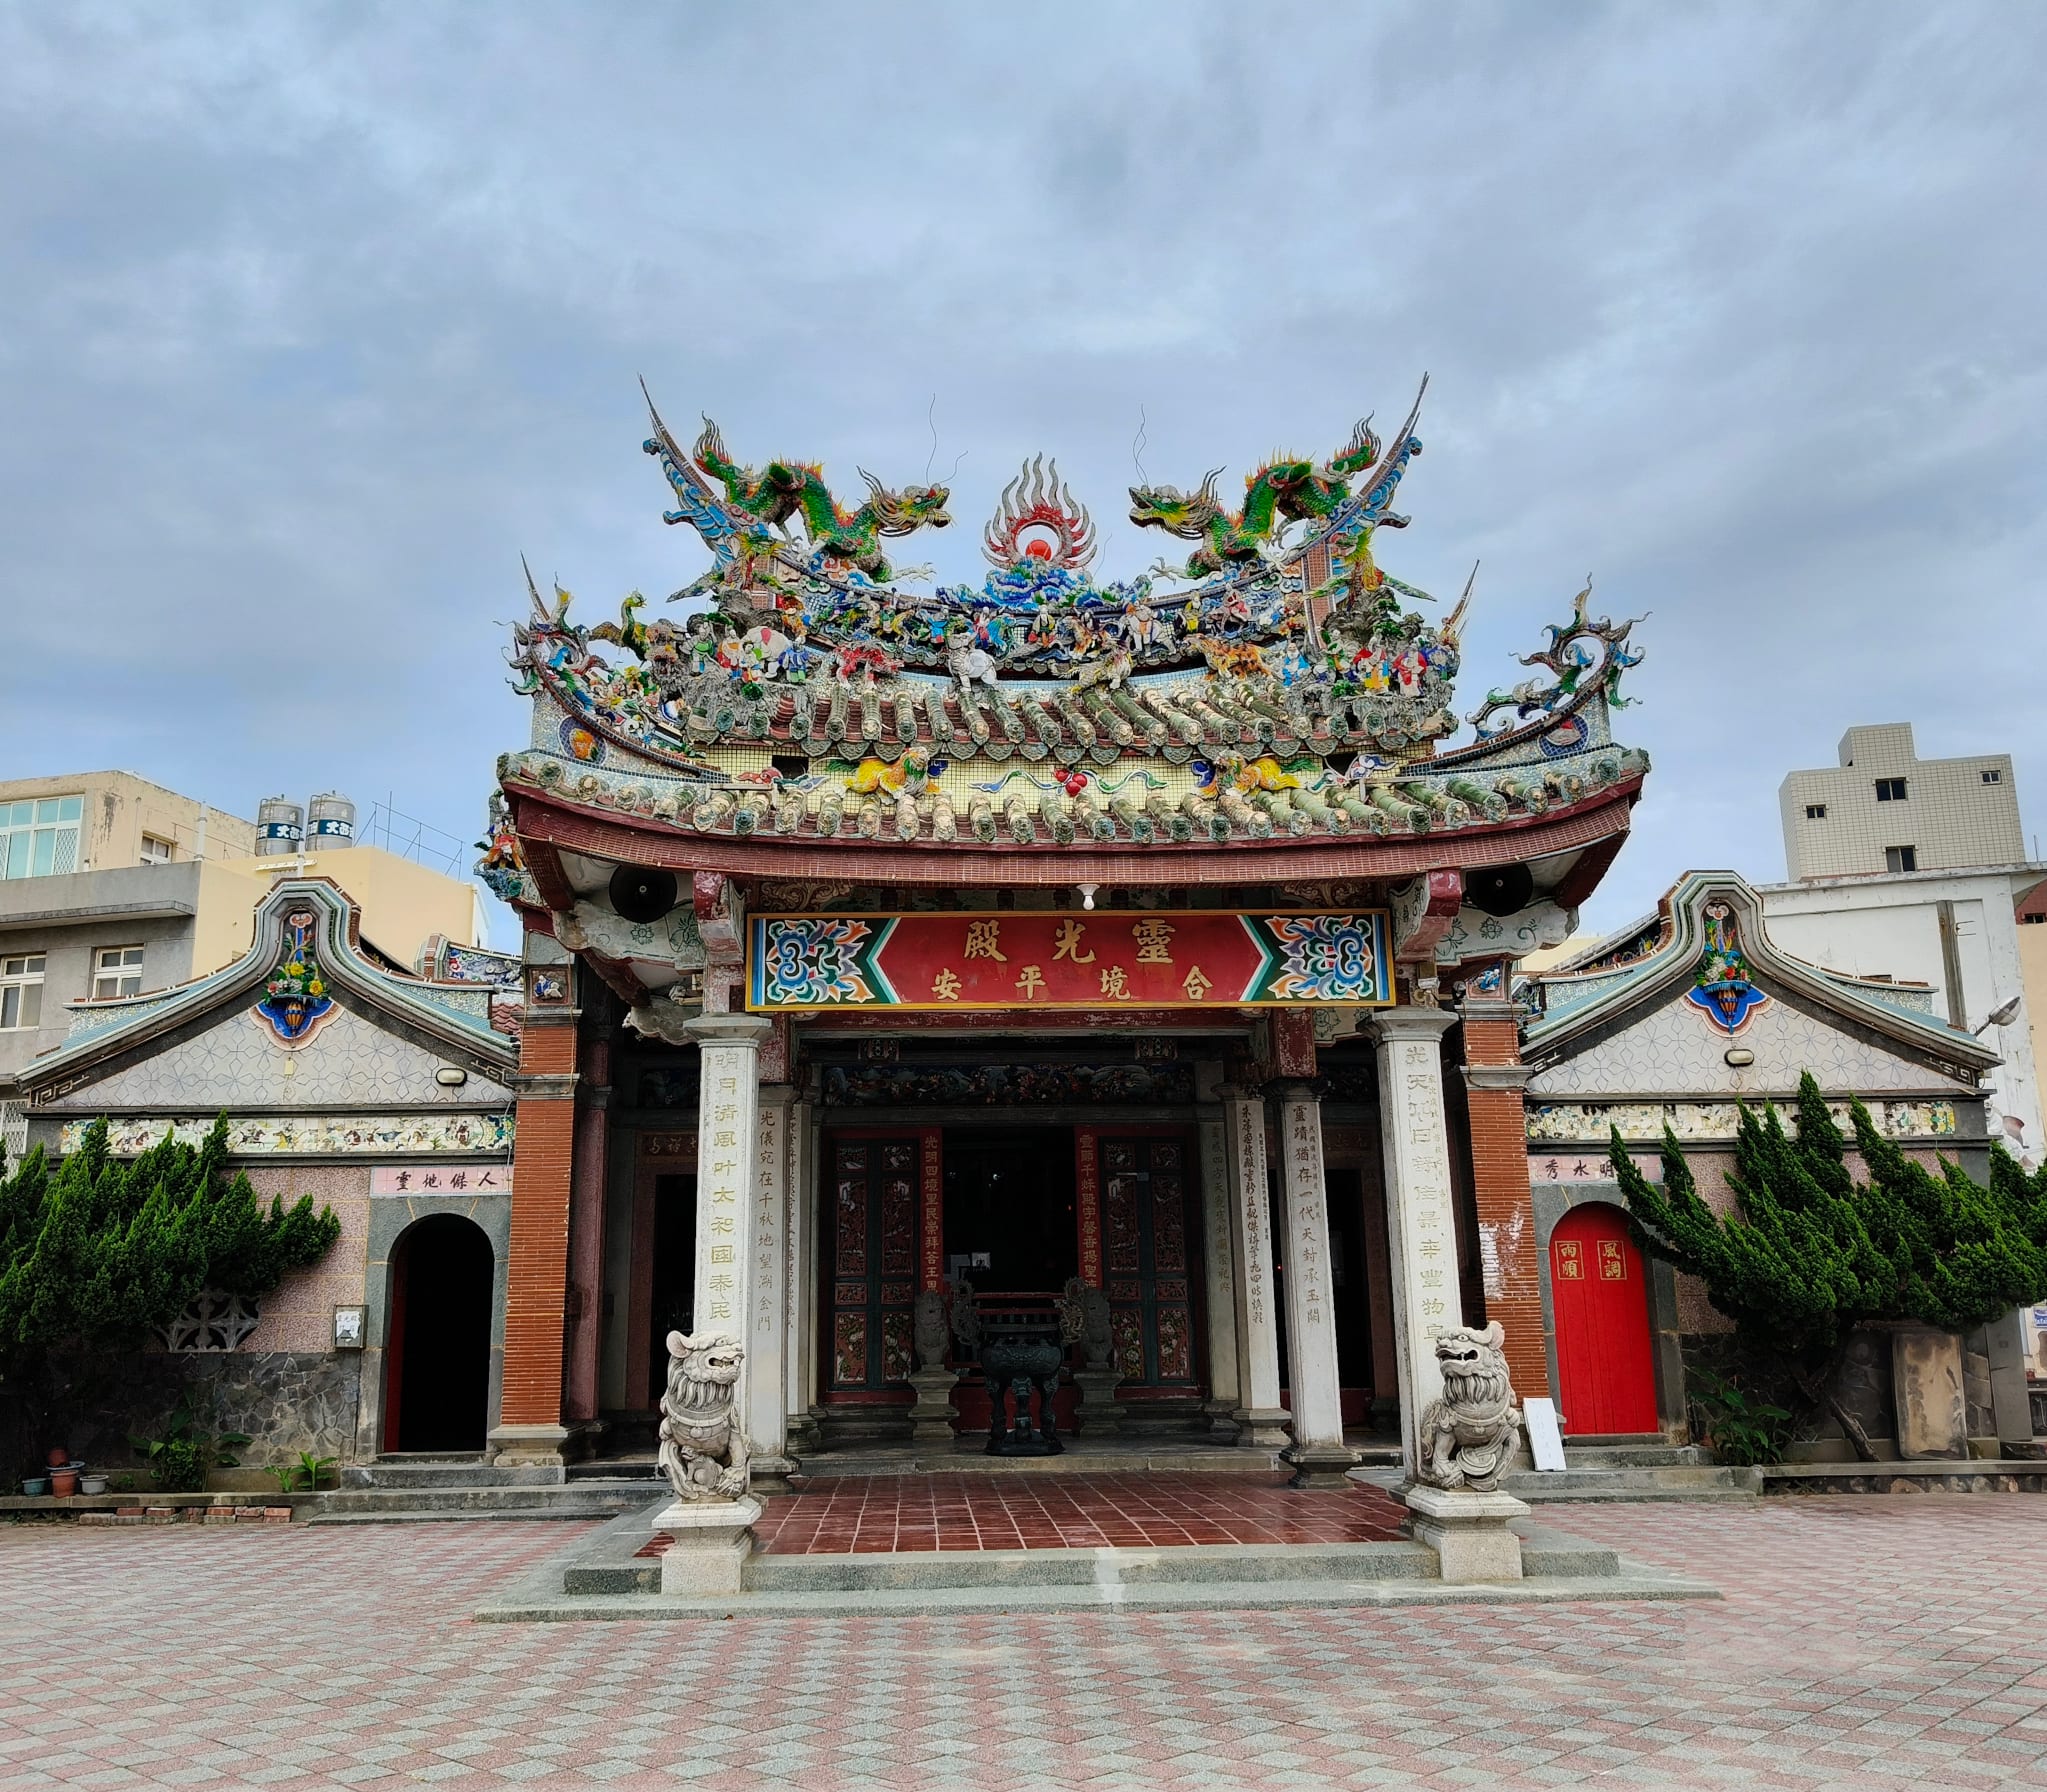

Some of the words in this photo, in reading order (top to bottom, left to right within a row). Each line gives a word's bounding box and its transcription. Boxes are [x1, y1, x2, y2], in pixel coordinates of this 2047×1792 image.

[964, 918, 1174, 964] 靈光殿
[930, 964, 1214, 1002] 合境平安
